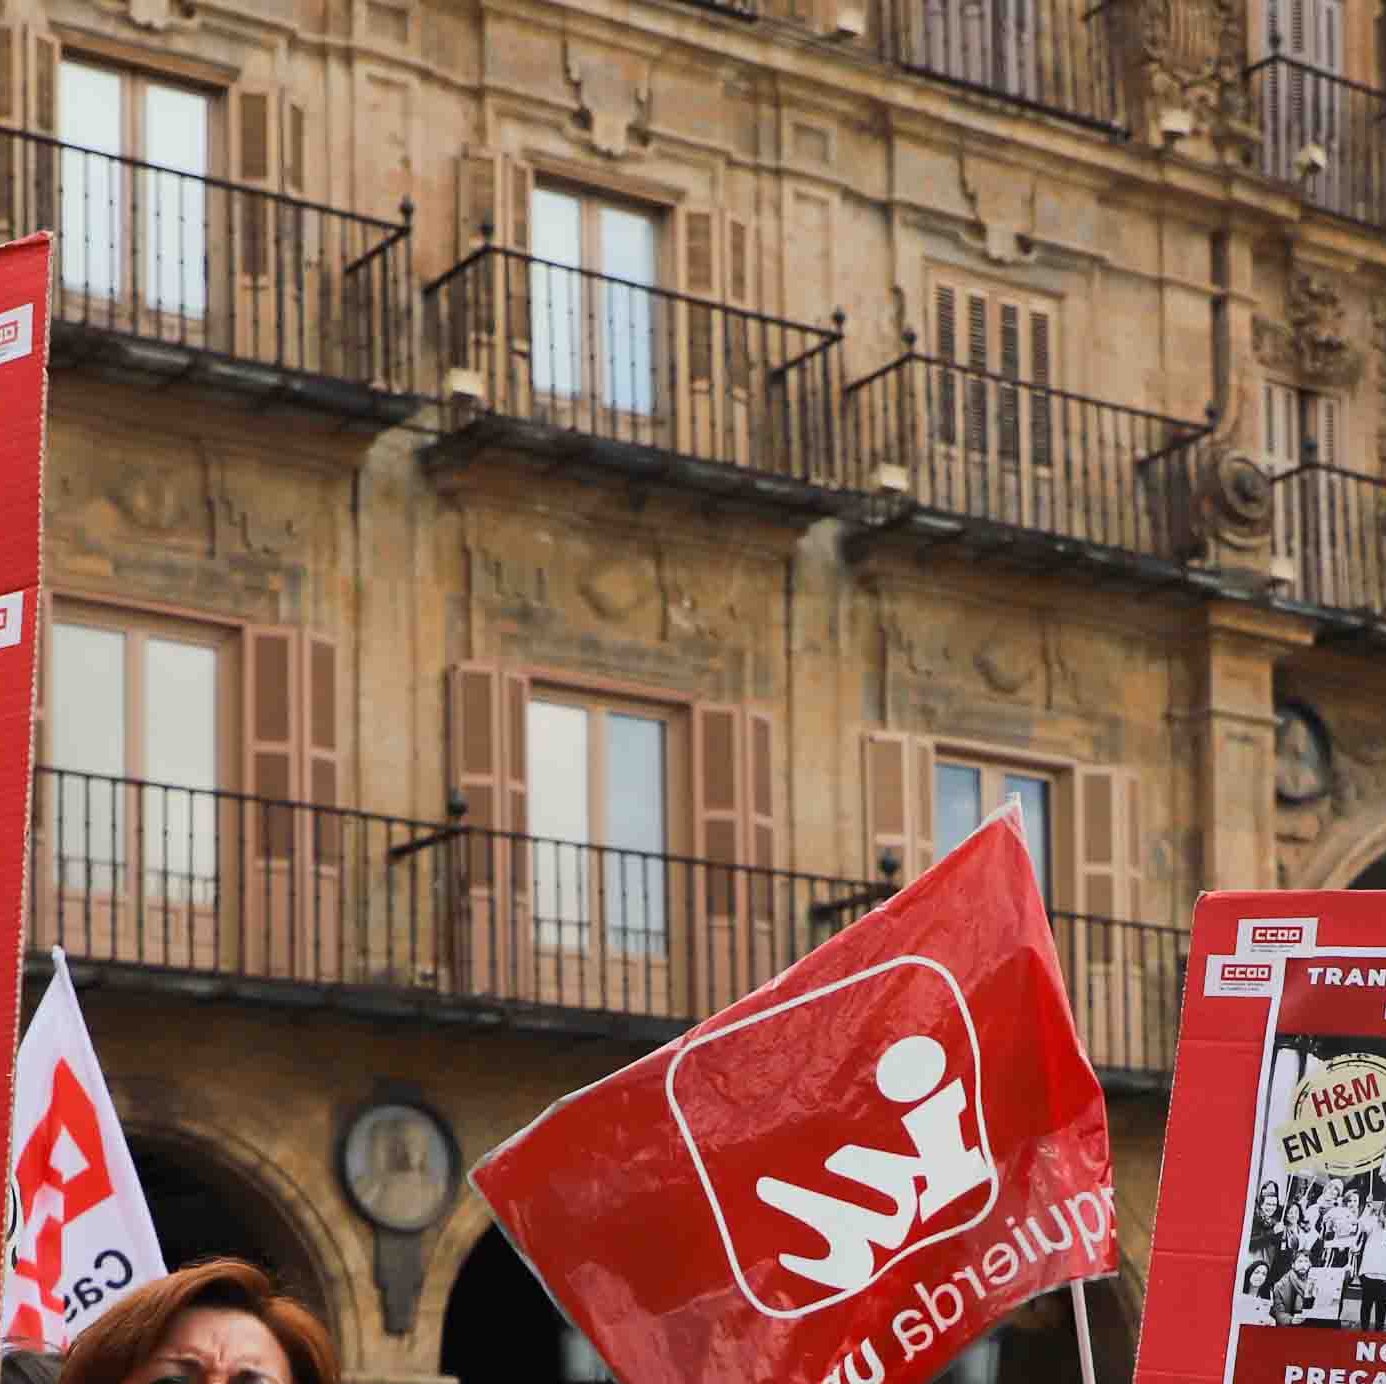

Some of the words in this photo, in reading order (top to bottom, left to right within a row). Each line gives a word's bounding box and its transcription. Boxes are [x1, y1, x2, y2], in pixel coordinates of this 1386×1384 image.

[1255, 929, 1301, 942] CCOO
[1223, 966, 1269, 979] CCOO
[1311, 1072, 1381, 1118] H&M
[1281, 1128, 1323, 1165] EN
